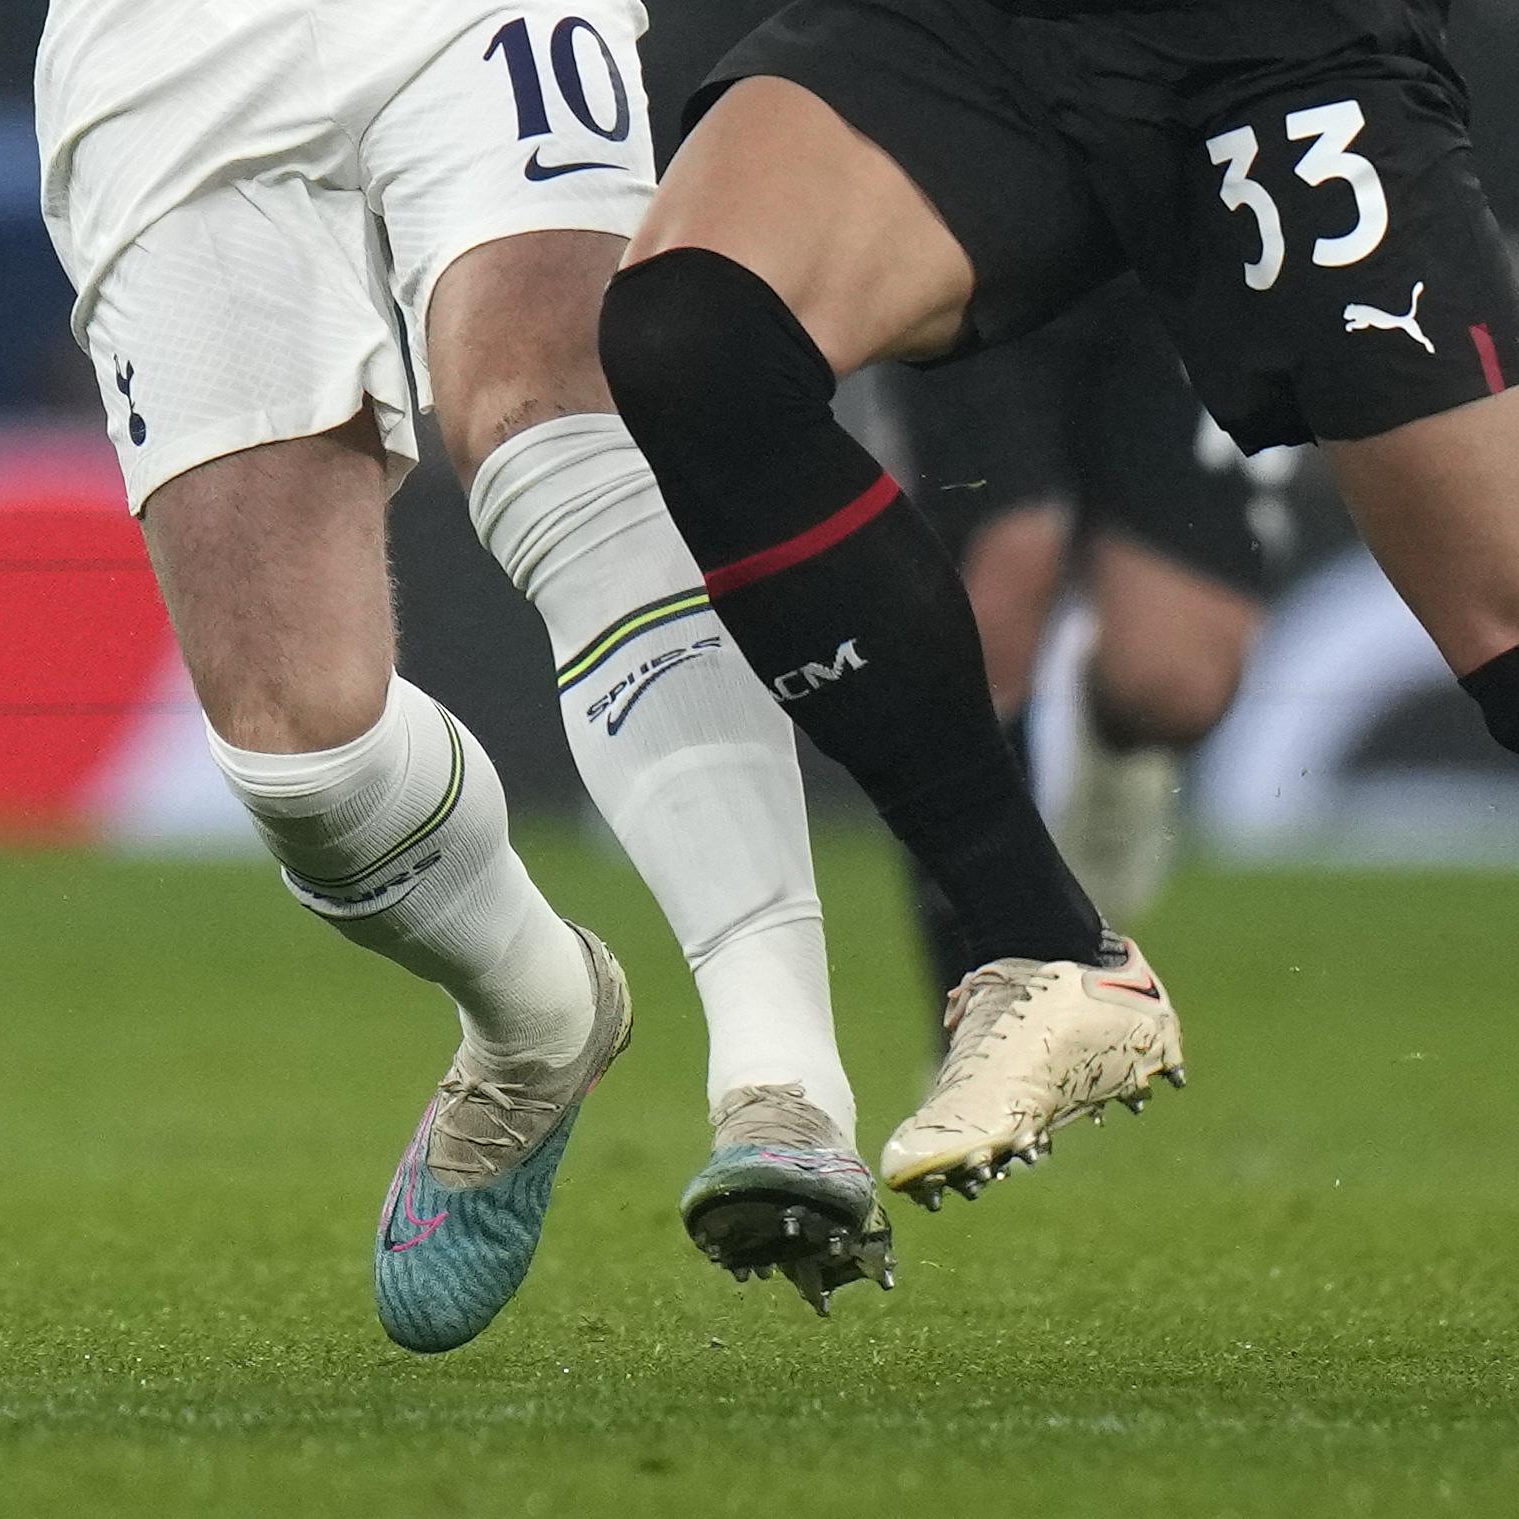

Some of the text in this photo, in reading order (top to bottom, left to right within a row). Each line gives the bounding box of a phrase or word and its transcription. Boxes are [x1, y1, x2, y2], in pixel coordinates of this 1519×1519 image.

[483, 16, 630, 142] 10
[1206, 99, 1389, 291] 33
[769, 637, 869, 703] CM
